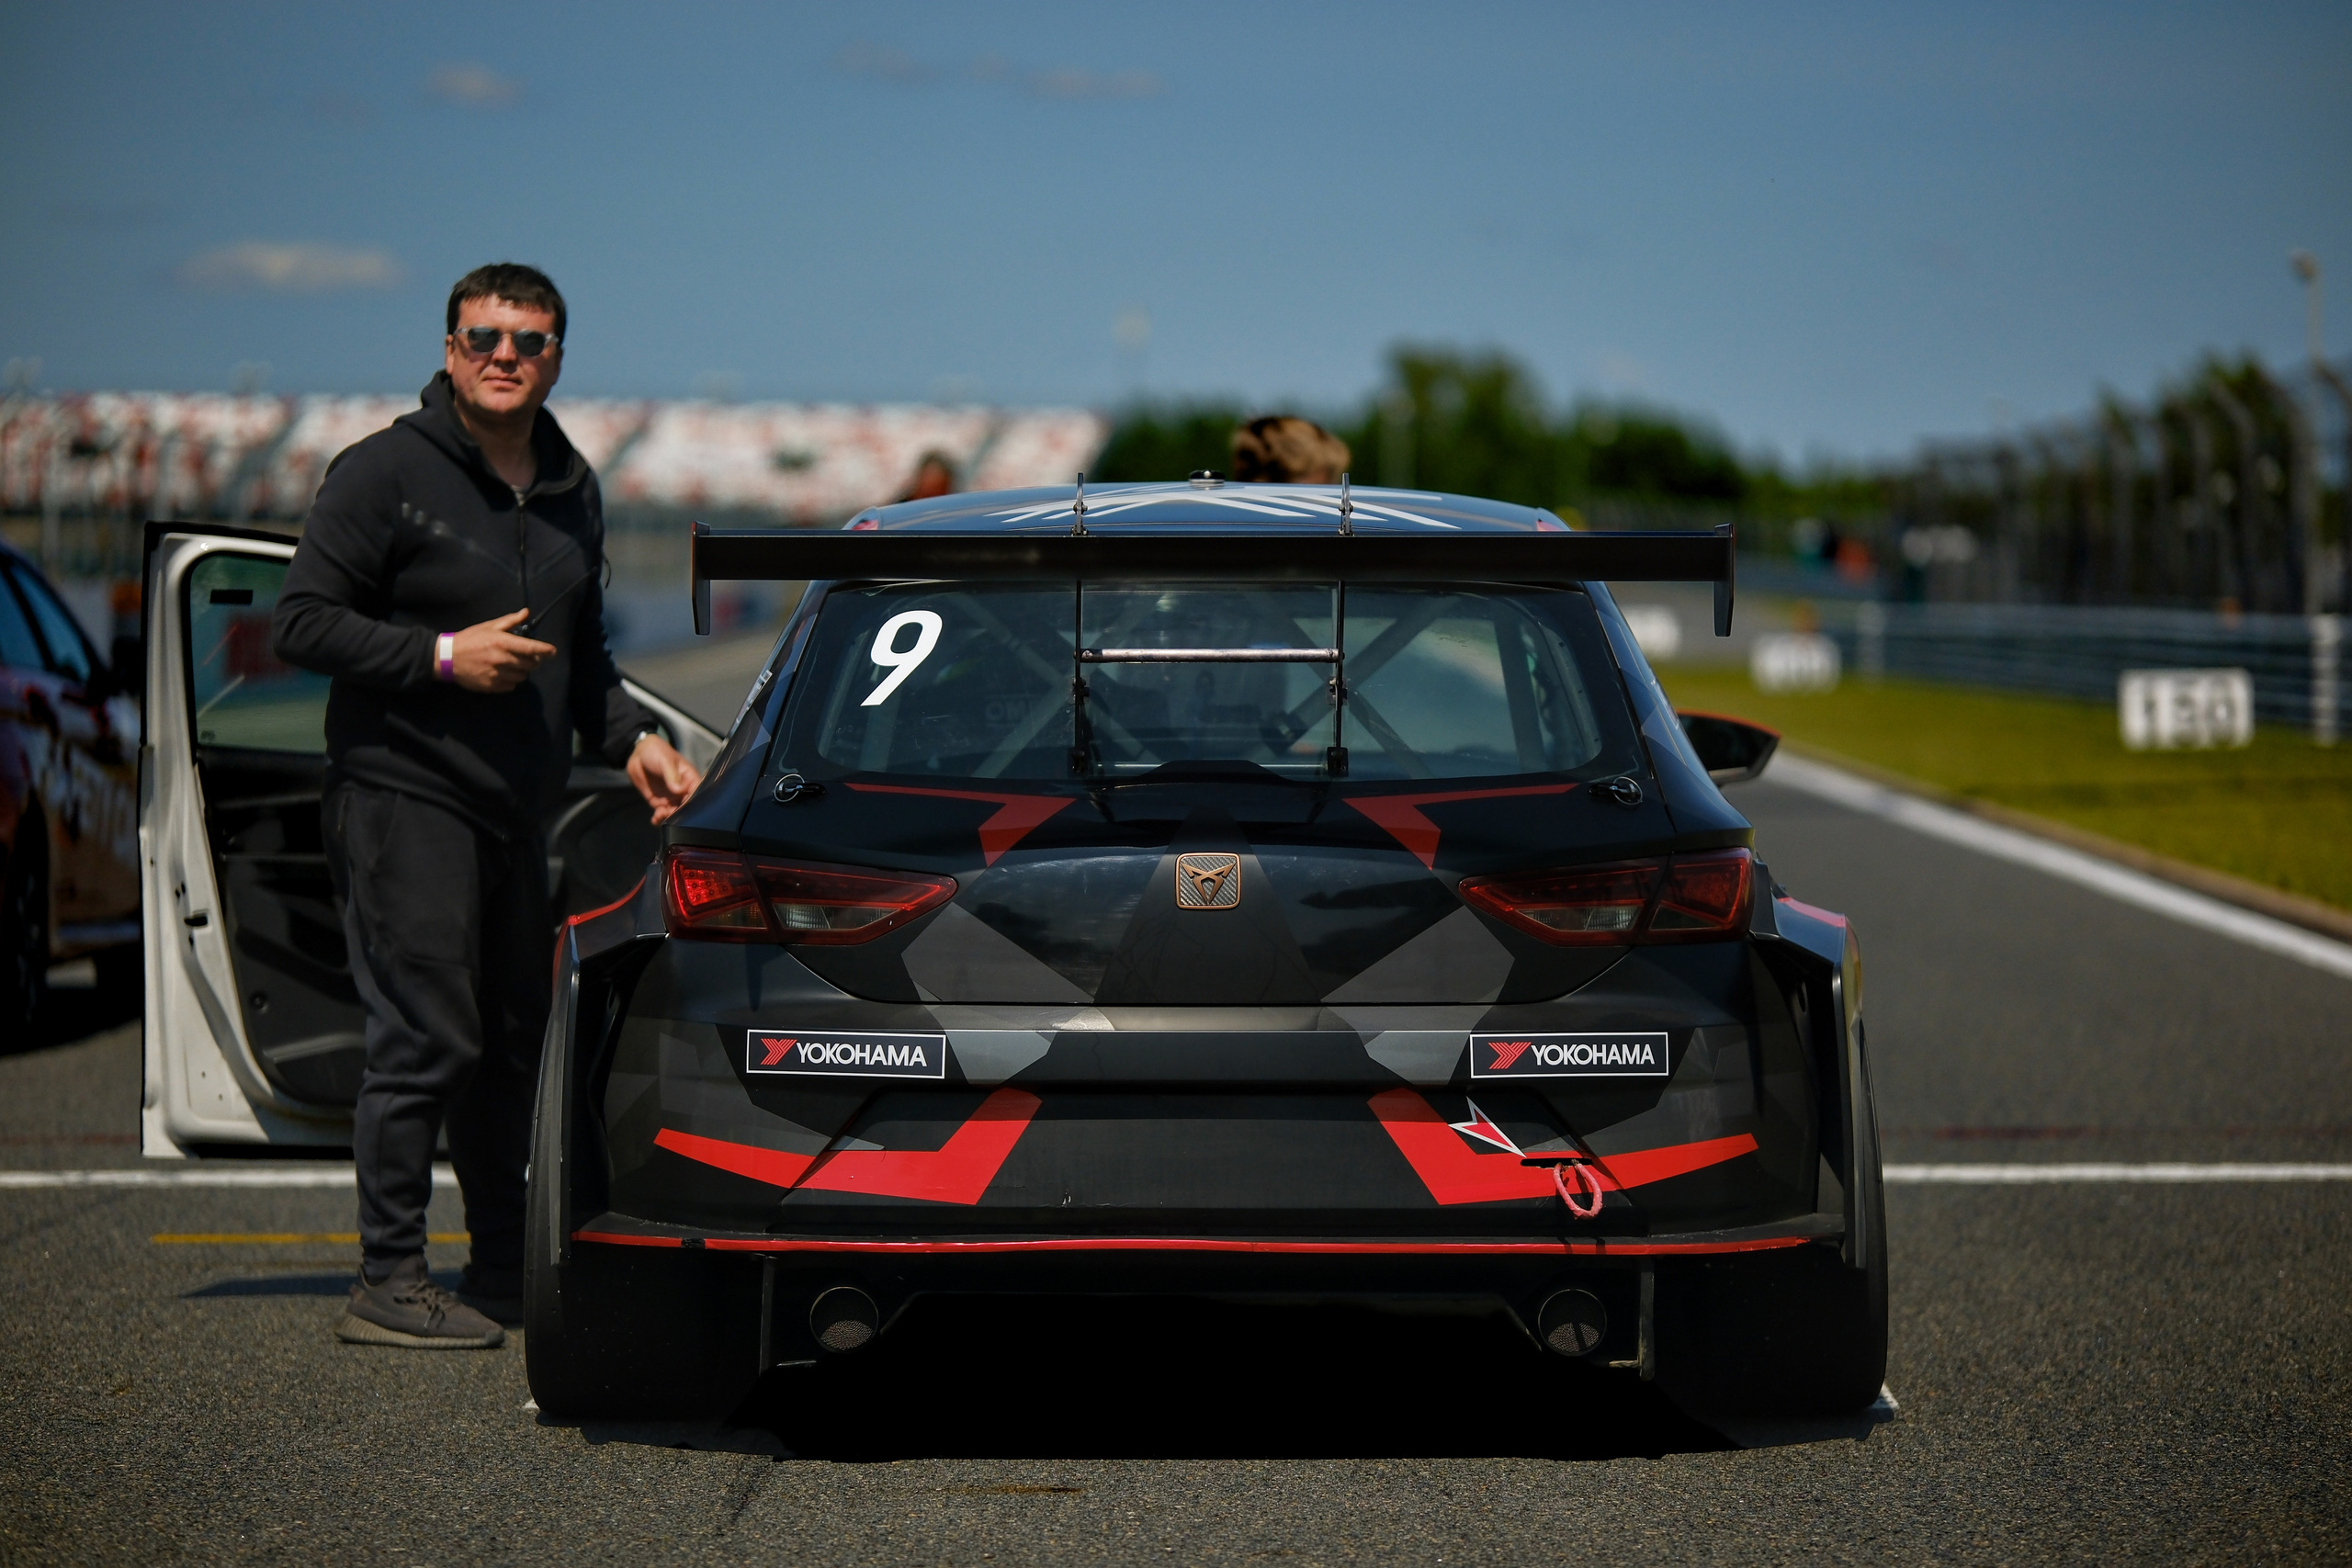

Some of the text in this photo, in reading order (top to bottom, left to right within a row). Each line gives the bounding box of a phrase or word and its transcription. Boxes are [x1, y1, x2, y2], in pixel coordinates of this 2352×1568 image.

[860, 609, 944, 707] 9
[796, 1043, 928, 1067] YOKOHAMA
[1531, 1043, 1656, 1066] YOKOHAMA
